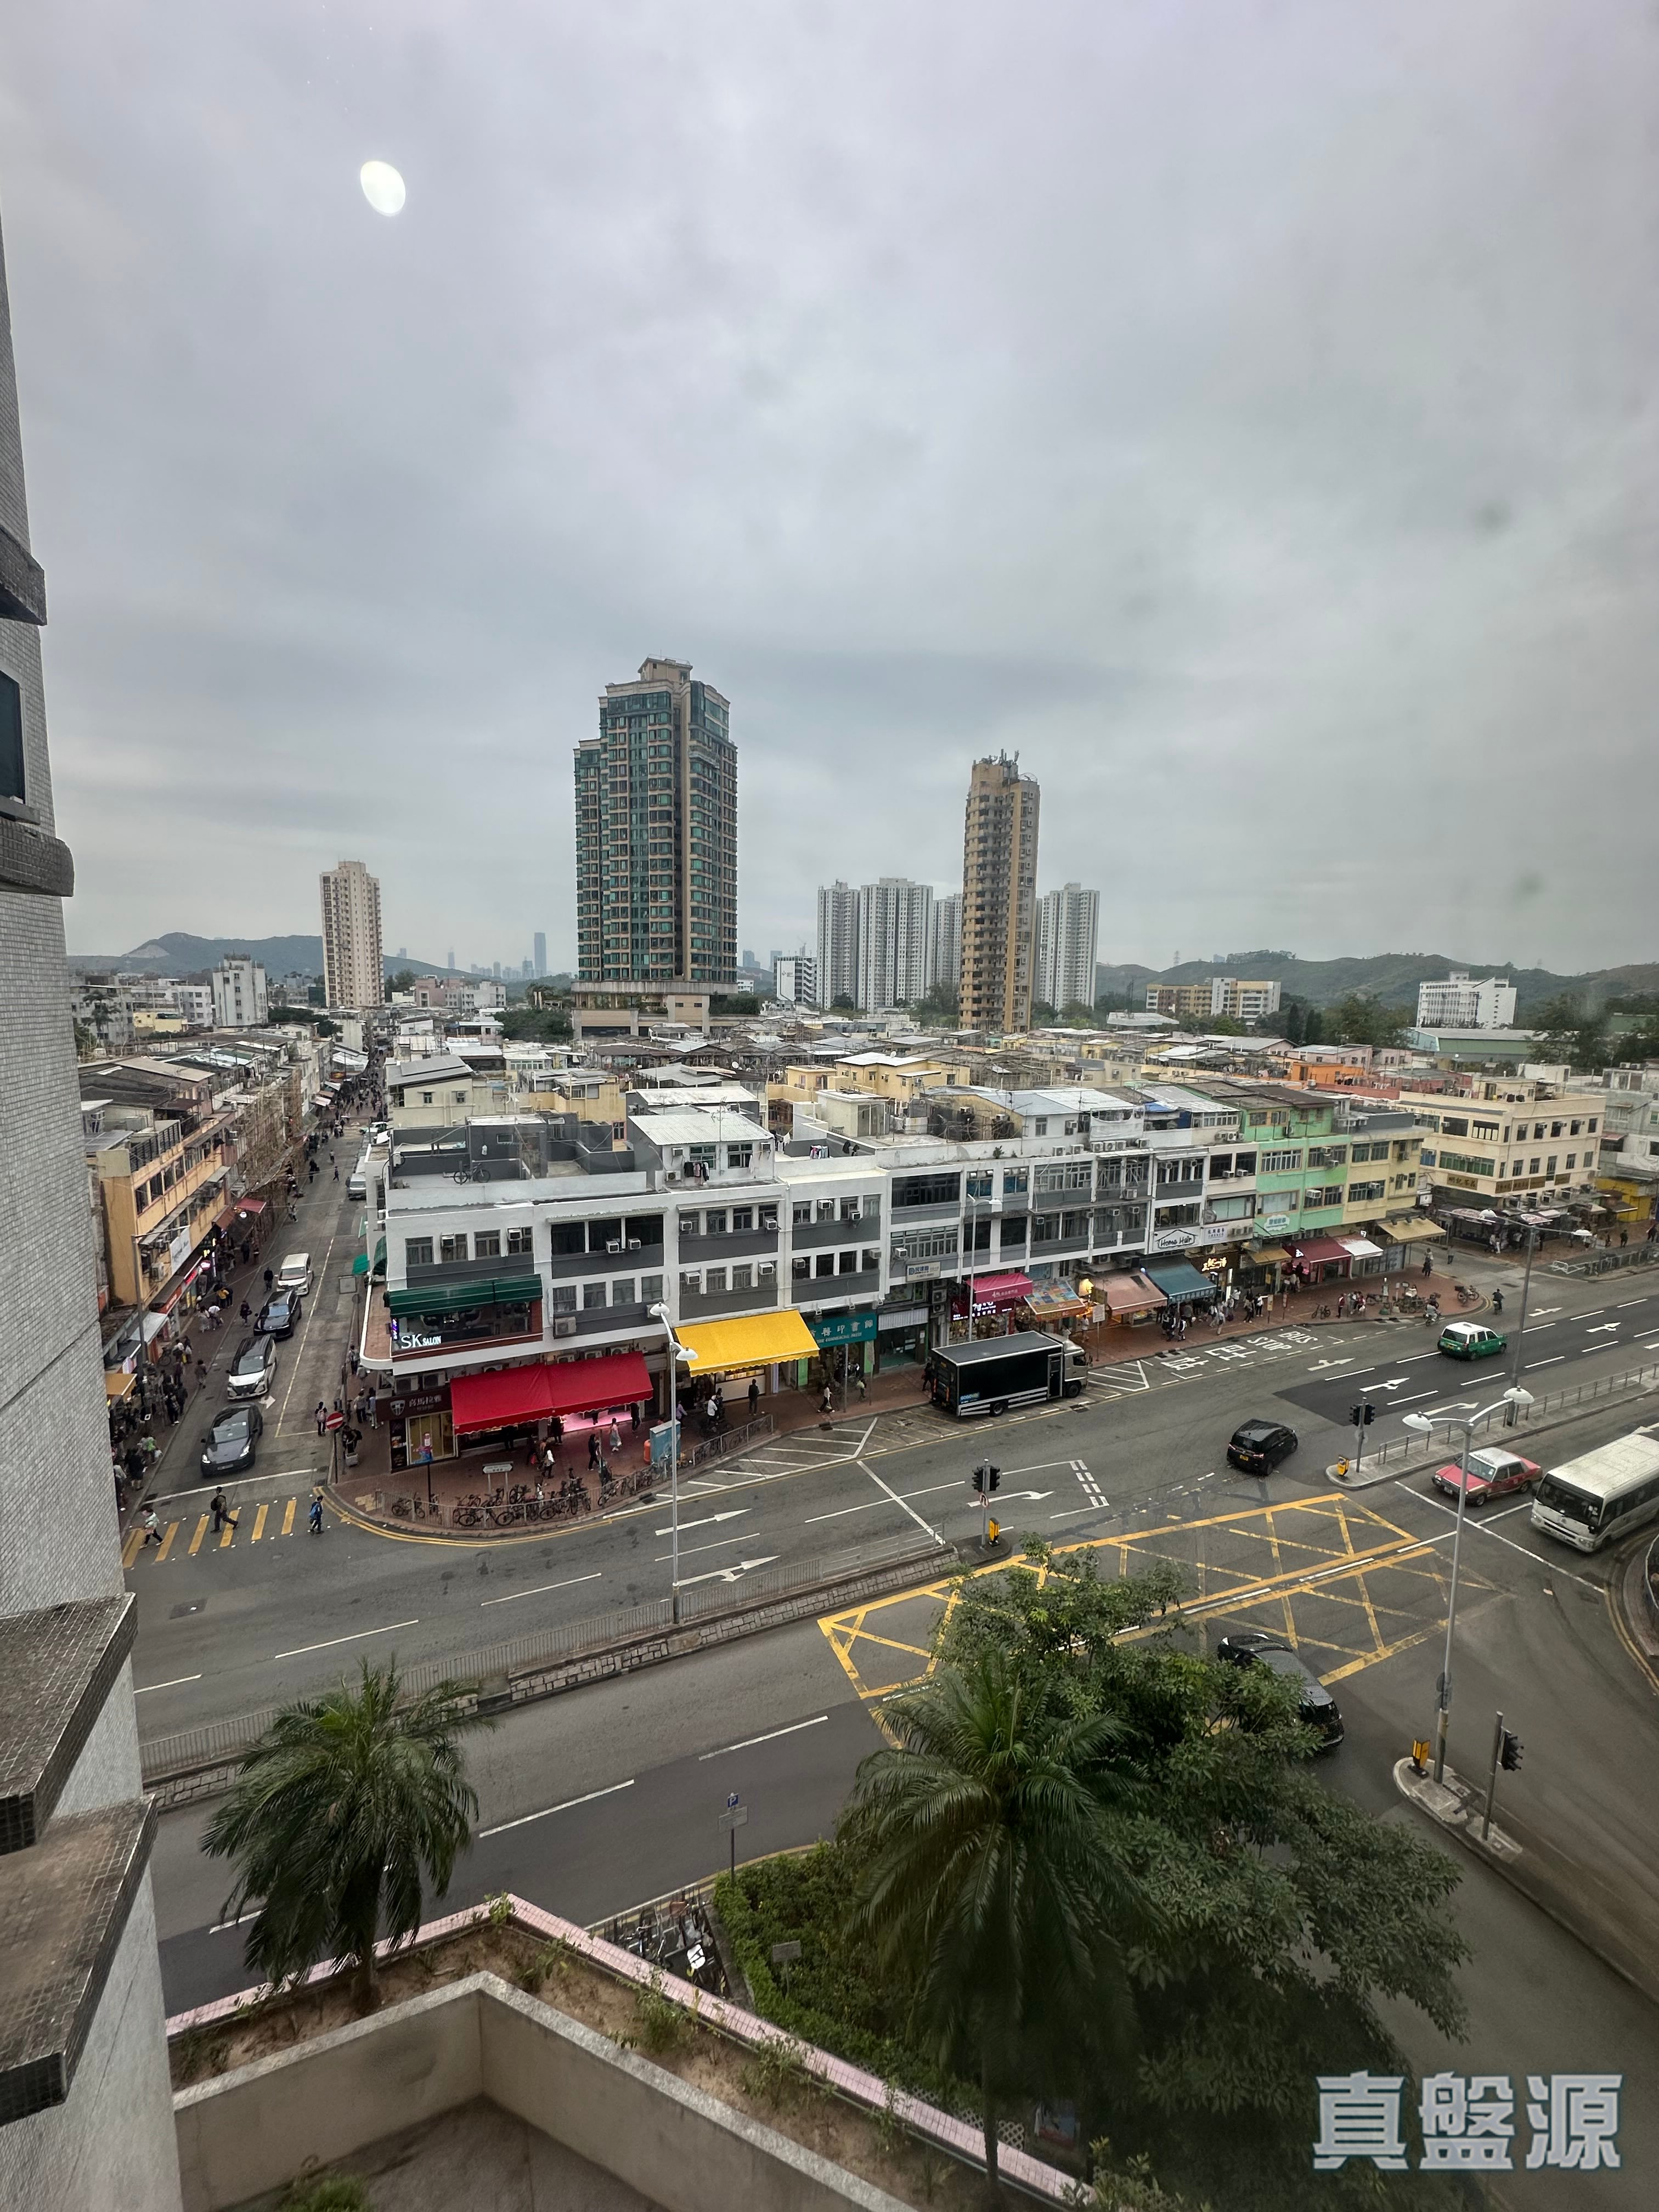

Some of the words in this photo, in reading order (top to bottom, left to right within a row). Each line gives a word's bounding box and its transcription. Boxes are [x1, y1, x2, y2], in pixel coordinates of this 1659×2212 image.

[1179, 1235, 1192, 1244] Hair
[401, 1333, 422, 1349] SK
[422, 1335, 441, 1346] SALON
[1247, 1337, 1292, 1351] STOP
[1278, 1331, 1318, 1343] BUS
[1204, 1344, 1257, 1361] 巴士
[1160, 1356, 1209, 1370] 站
